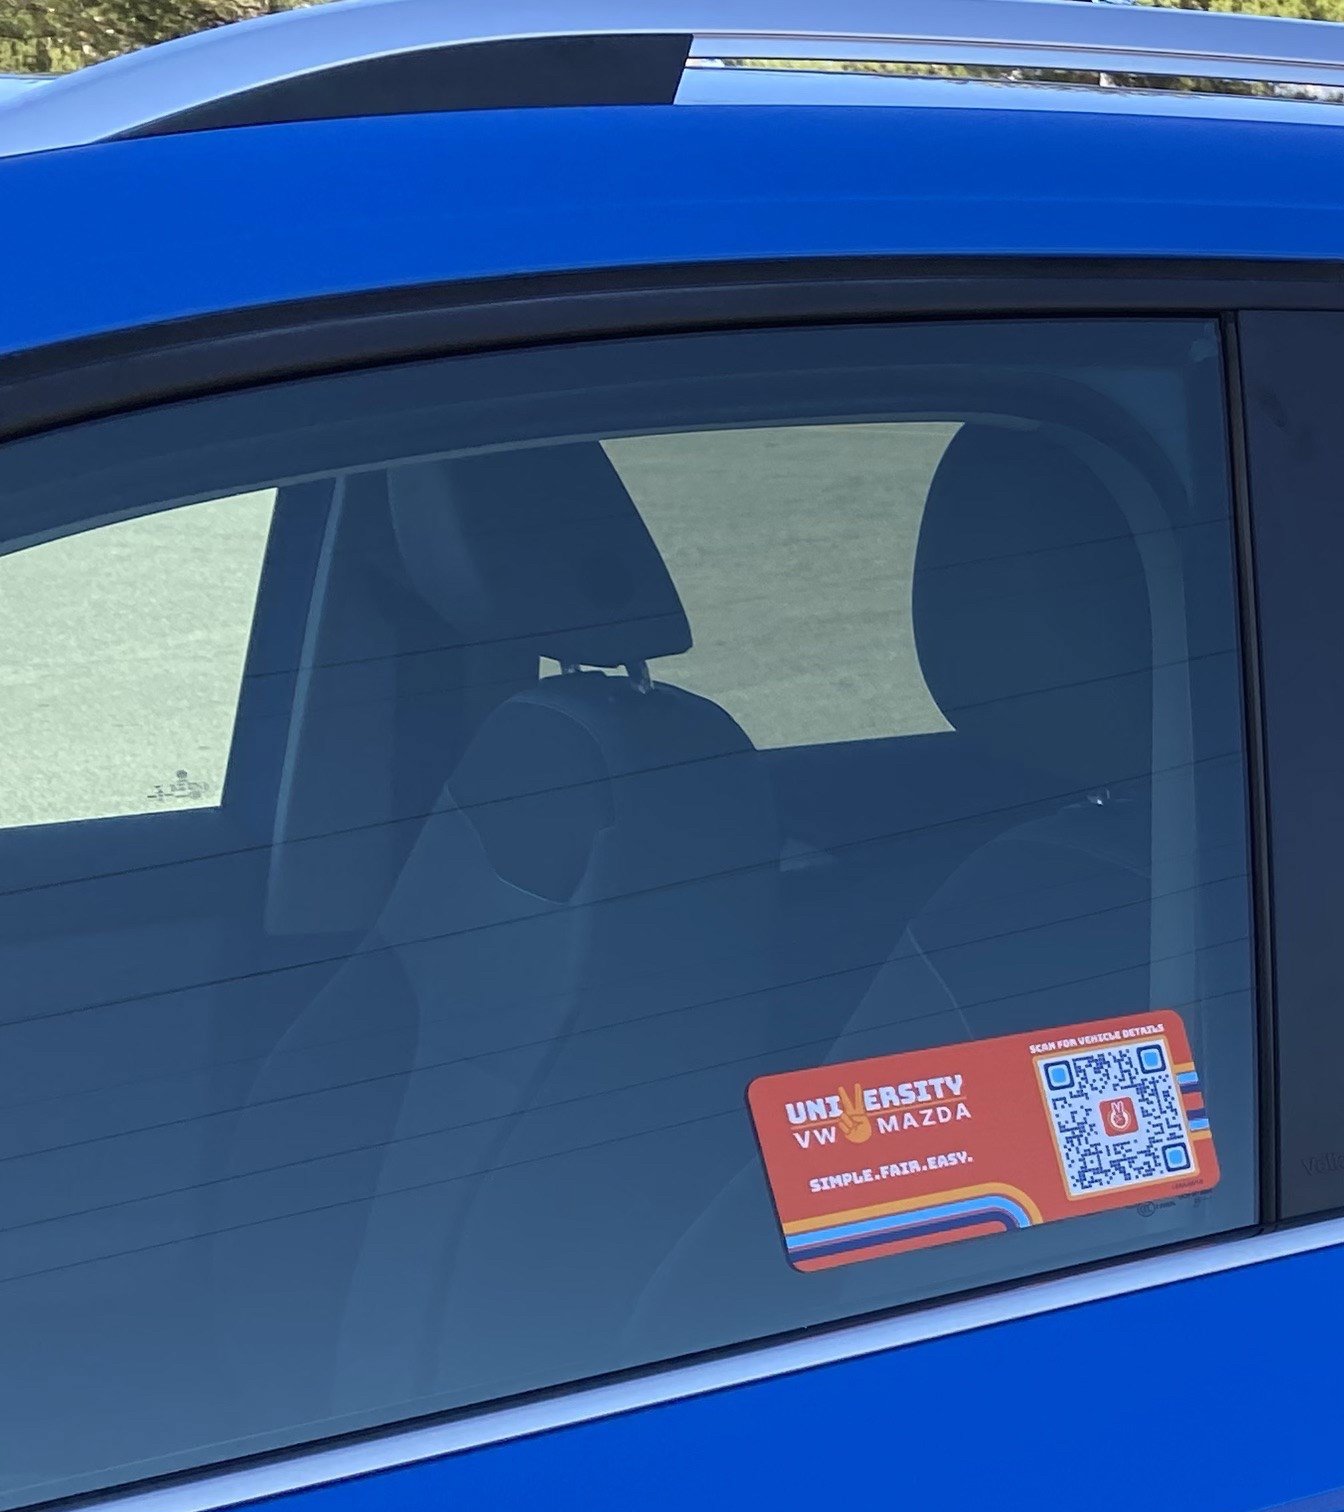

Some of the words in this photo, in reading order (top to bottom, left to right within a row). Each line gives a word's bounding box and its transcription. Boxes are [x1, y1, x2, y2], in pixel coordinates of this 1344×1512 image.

[1029, 1042, 1056, 1054] SCAN
[1057, 1038, 1078, 1050] FOR
[1078, 1031, 1121, 1046] VEHICLE
[1122, 1023, 1165, 1038] DETAILS
[785, 1073, 963, 1126] UNIVERSITY
[793, 1126, 837, 1149] VW
[878, 1103, 972, 1135] MAZDA
